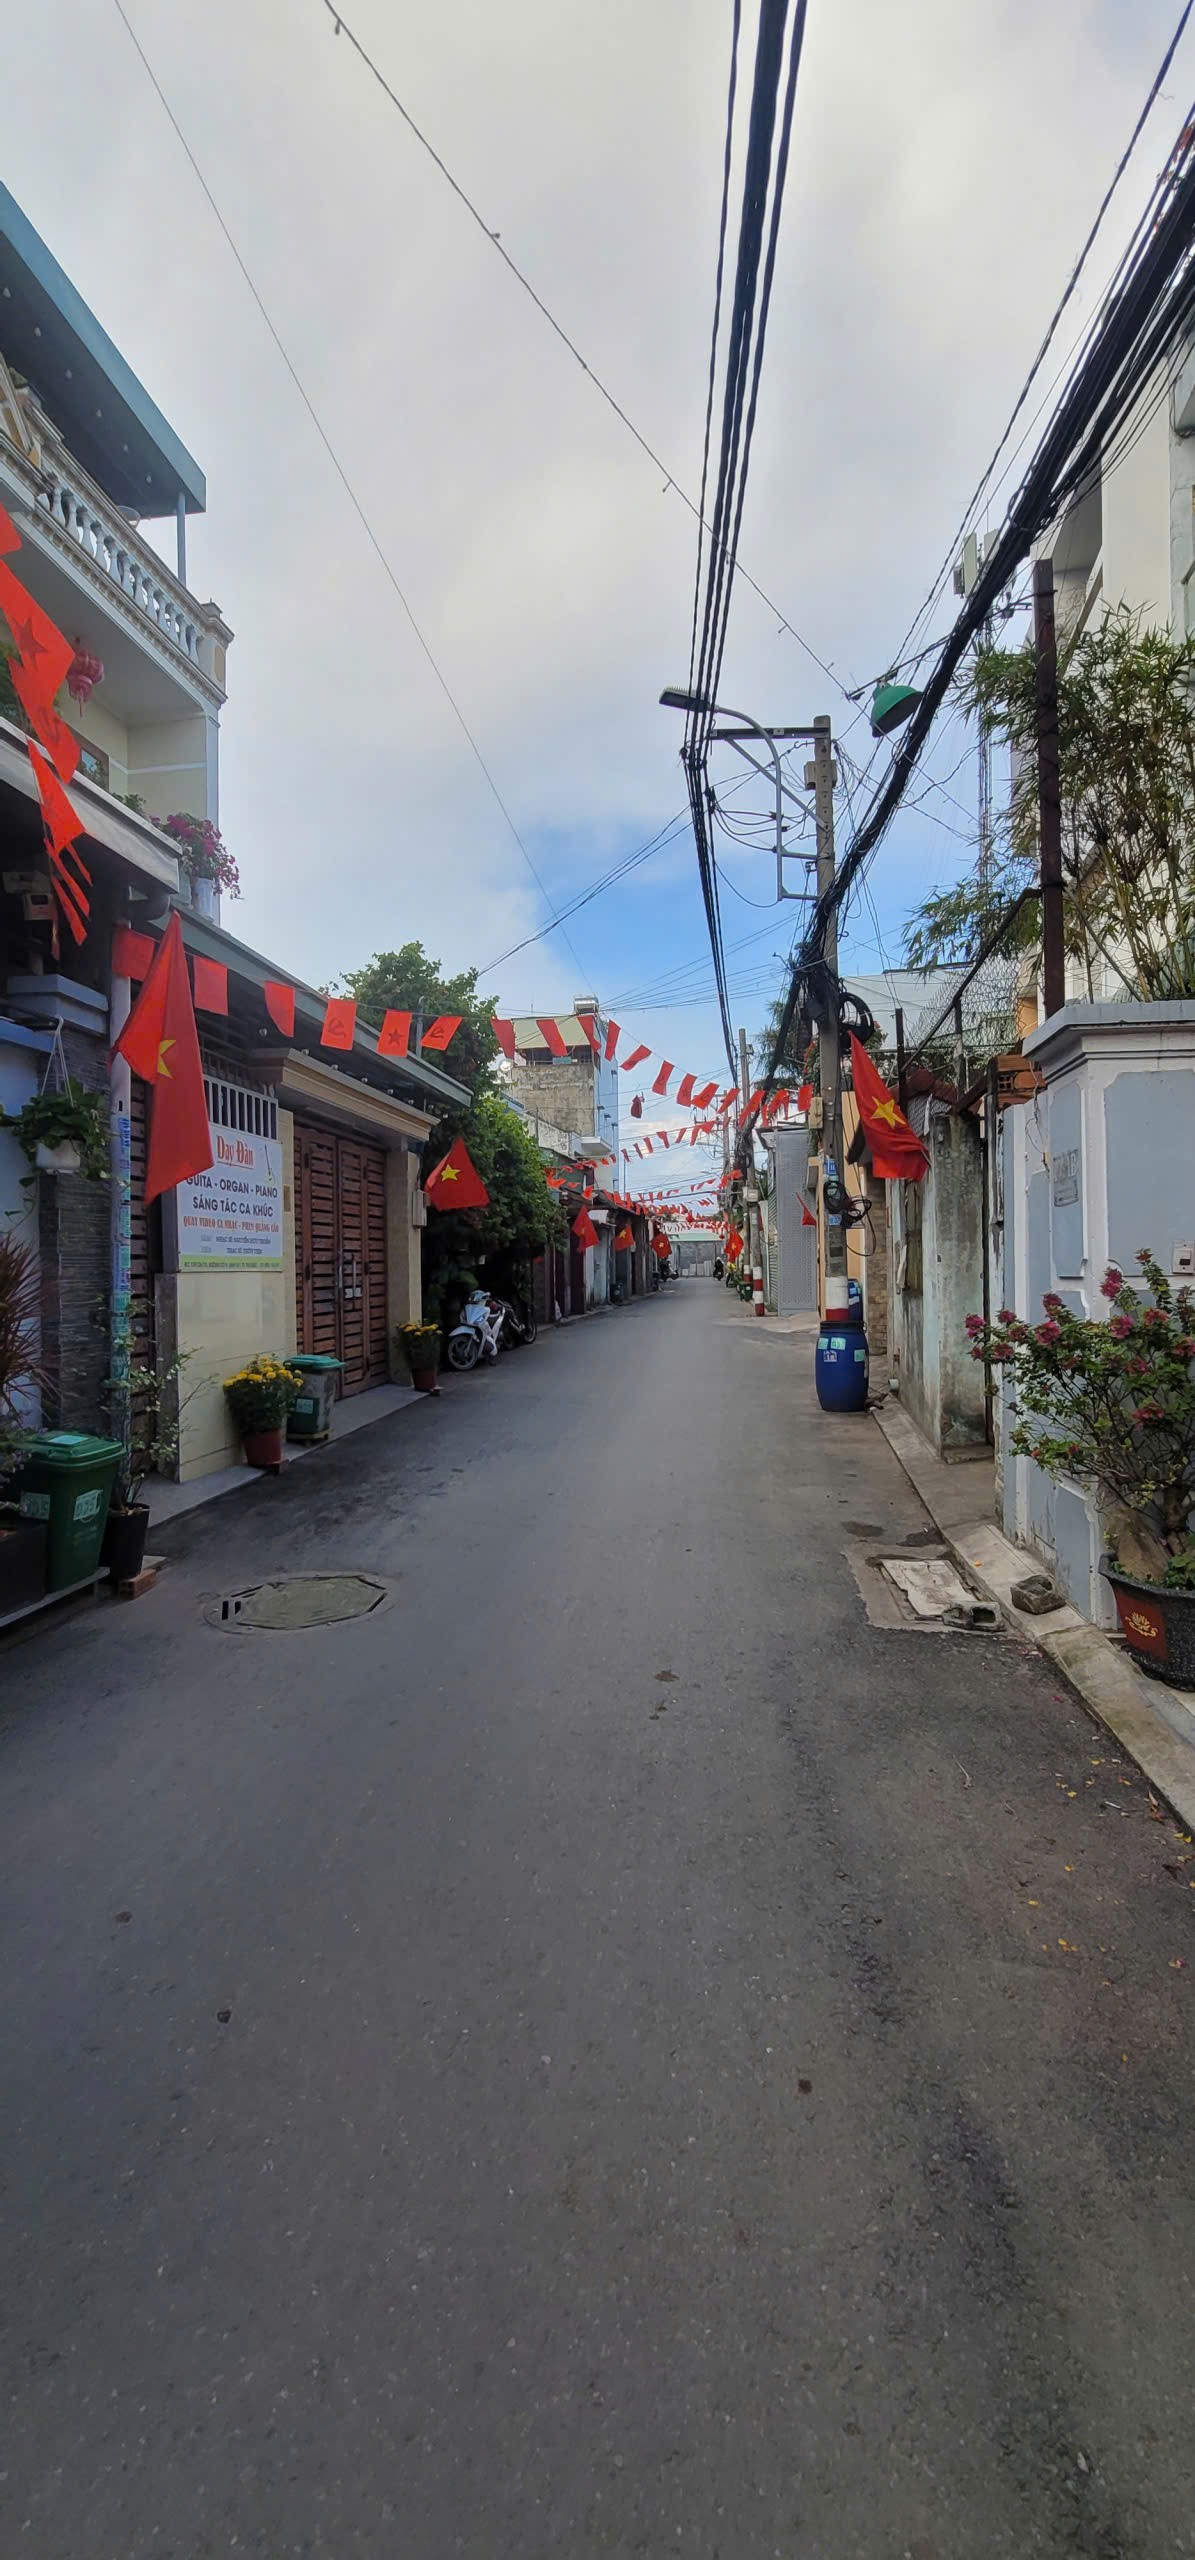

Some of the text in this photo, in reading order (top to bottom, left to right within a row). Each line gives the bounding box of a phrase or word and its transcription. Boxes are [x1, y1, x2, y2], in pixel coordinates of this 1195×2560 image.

[219, 1179, 249, 1194] ORGAN
[255, 1185, 278, 1198] PIANO
[193, 1194, 274, 1217] SÁNG TÁC CA KHÚC
[183, 1216, 198, 1227] QUAY
[199, 1217, 216, 1228] VIDEO
